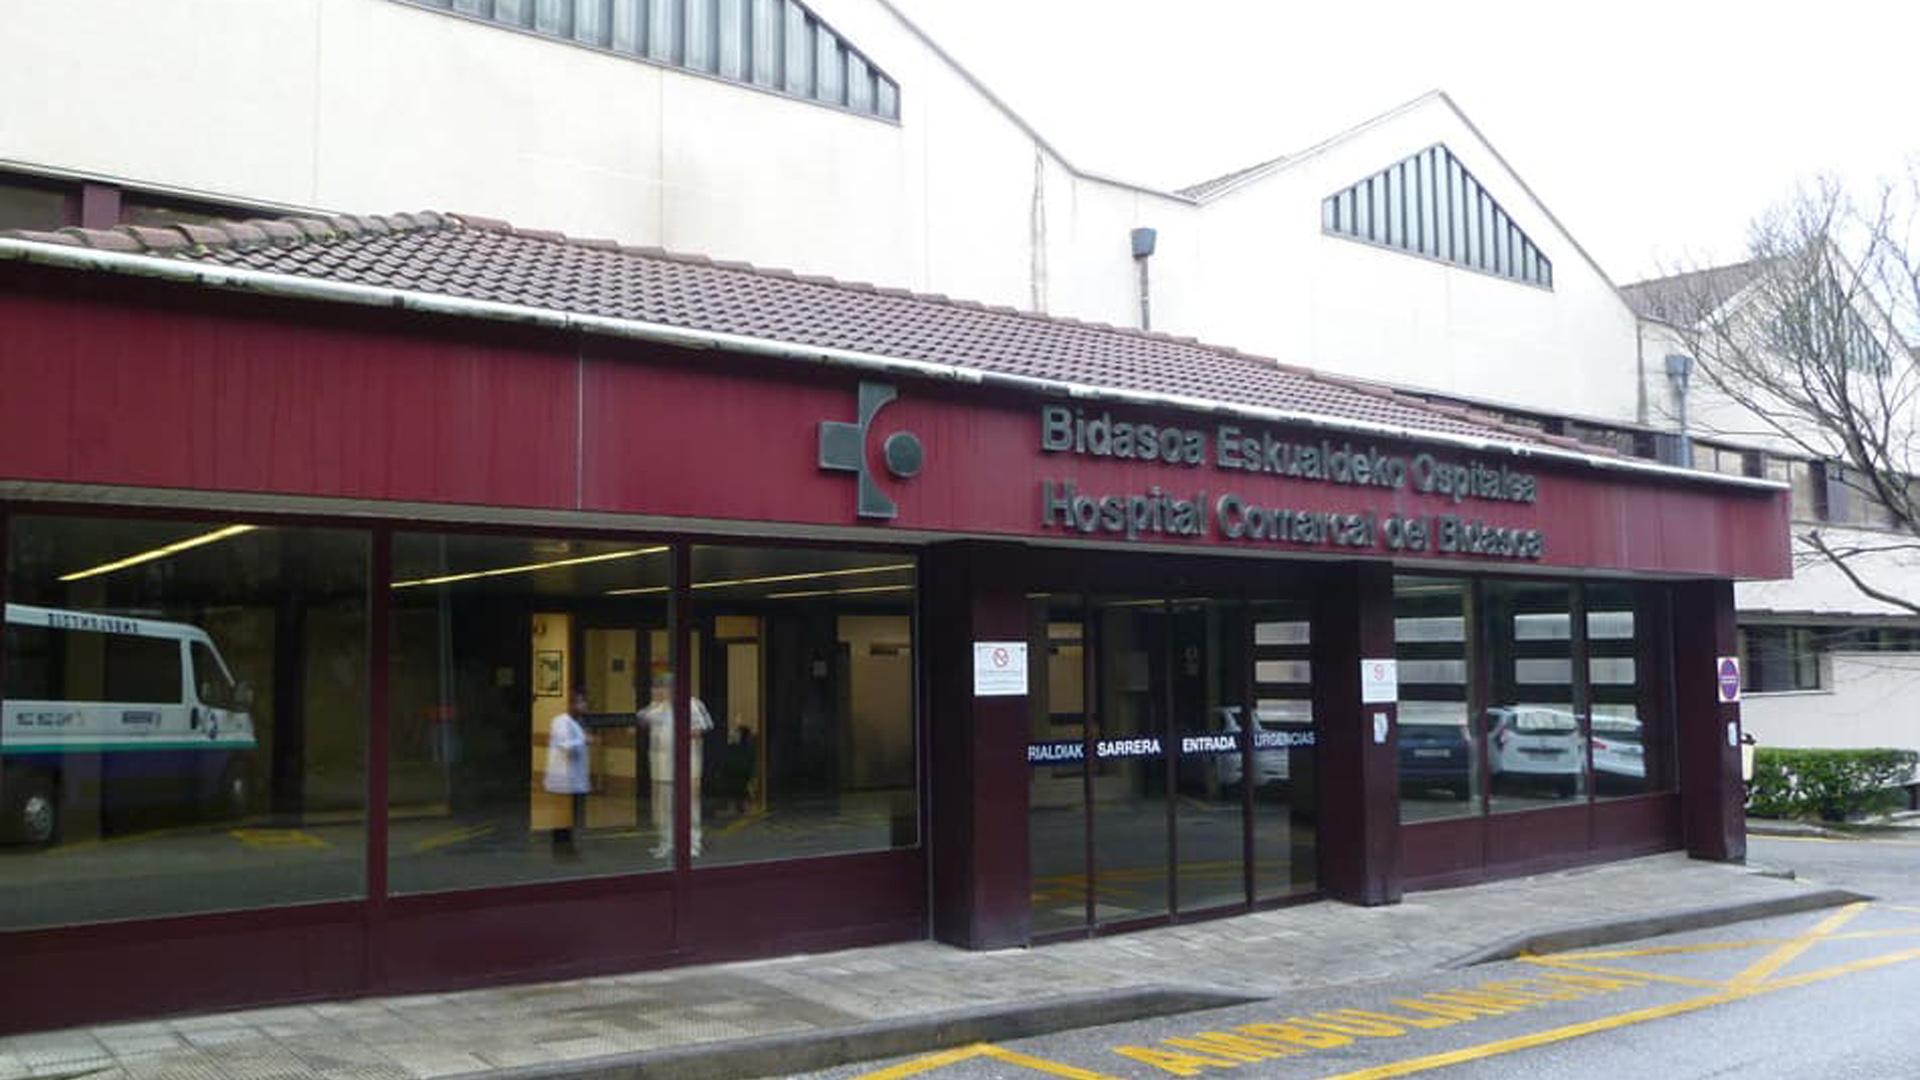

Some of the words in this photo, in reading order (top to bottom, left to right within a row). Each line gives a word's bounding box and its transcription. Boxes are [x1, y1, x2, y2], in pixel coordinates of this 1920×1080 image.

[1042, 405, 1206, 466] Bidasoa
[1216, 424, 1406, 489] Eskualdeko
[1411, 453, 1537, 503] Ospitalea
[1042, 478, 1208, 541] Hospital
[1216, 493, 1377, 549] Comarcal
[1384, 507, 1431, 551] del
[1438, 513, 1545, 559] Bidasoa
[1097, 737, 1162, 758] SARRERA
[1182, 735, 1238, 753] ENTRADA
[1254, 730, 1316, 748] URGENCIAS
